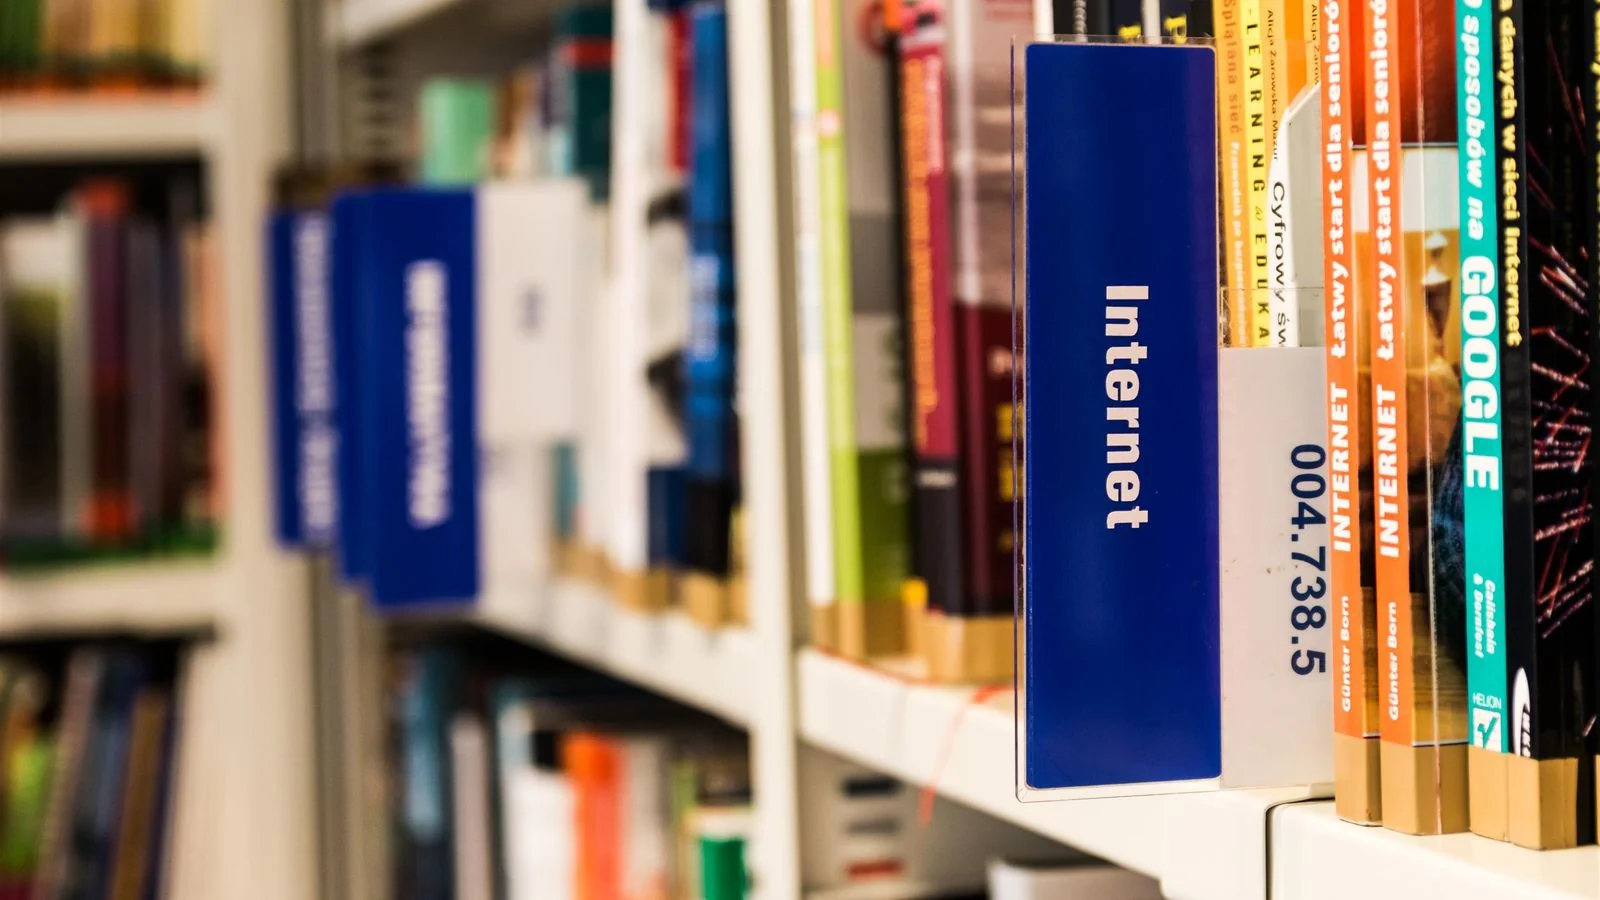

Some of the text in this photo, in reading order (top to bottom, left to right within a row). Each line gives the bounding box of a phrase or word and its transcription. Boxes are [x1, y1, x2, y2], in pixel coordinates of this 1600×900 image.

[1266, 9, 1277, 47] Alicja
[1310, 4, 1319, 41] Alicja
[1496, 16, 1518, 118] danych
[1372, 120, 1391, 172] dla
[1460, 14, 1485, 188] sposobów
[1501, 125, 1517, 151] w
[1270, 181, 1287, 304] Cyfrowy
[1376, 177, 1393, 255] start
[1466, 197, 1484, 241] na
[1503, 157, 1520, 220] sieci
[1322, 0, 1350, 552] INTERNET Łatwy start dla senioró
[1377, 262, 1398, 361] Łatwy
[1504, 227, 1523, 348] Internet
[1105, 284, 1150, 531] Internet
[1462, 255, 1499, 491] GOOGLE
[1377, 384, 1399, 559] INTERNET
[1290, 443, 1327, 677] 004.738.5
[1341, 596, 1352, 713] Günter Born
[1387, 602, 1400, 721] Günter Born
[1472, 692, 1501, 709] HELION
